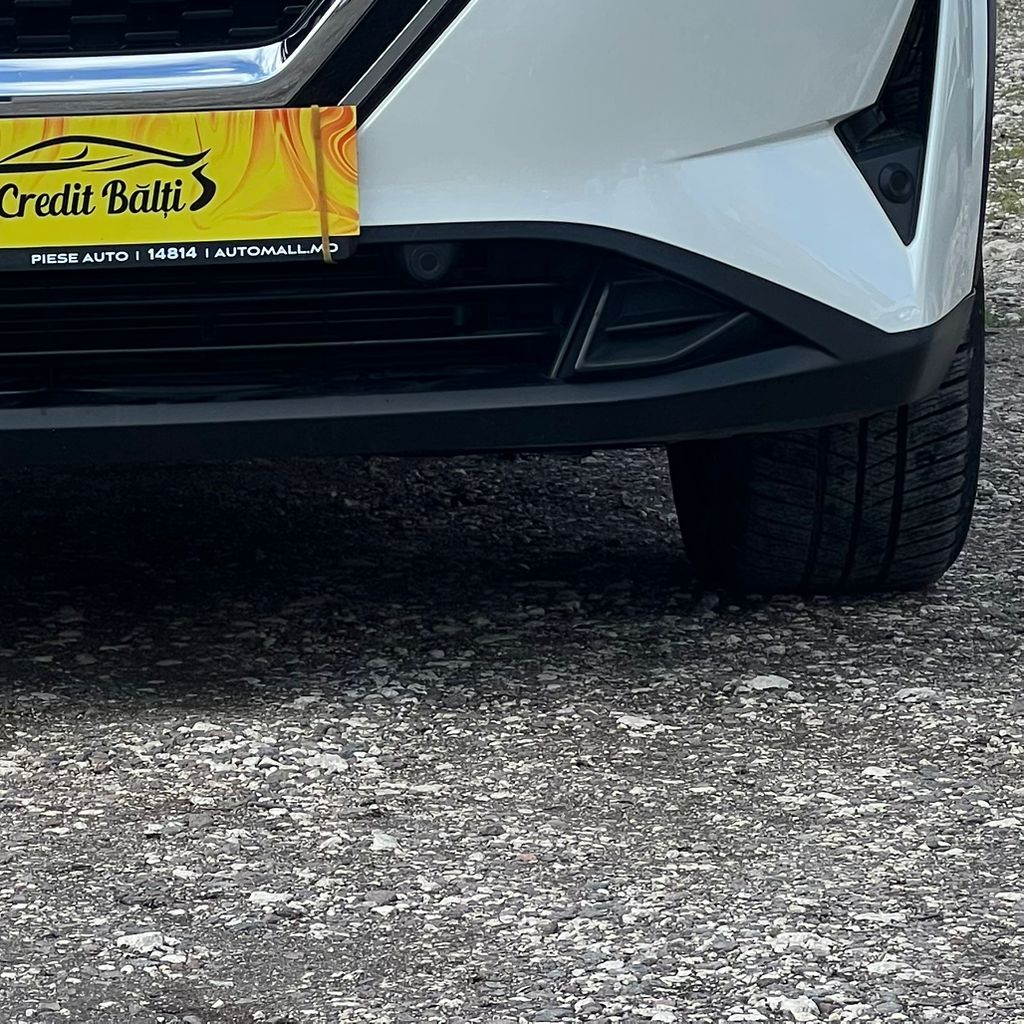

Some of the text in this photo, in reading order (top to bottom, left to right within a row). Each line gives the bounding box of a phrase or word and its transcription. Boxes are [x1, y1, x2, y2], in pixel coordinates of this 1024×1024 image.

[101, 178, 186, 219] Bălți
[31, 252, 79, 265] PIESE
[82, 250, 129, 264] AUTO
[148, 246, 198, 261] 14814
